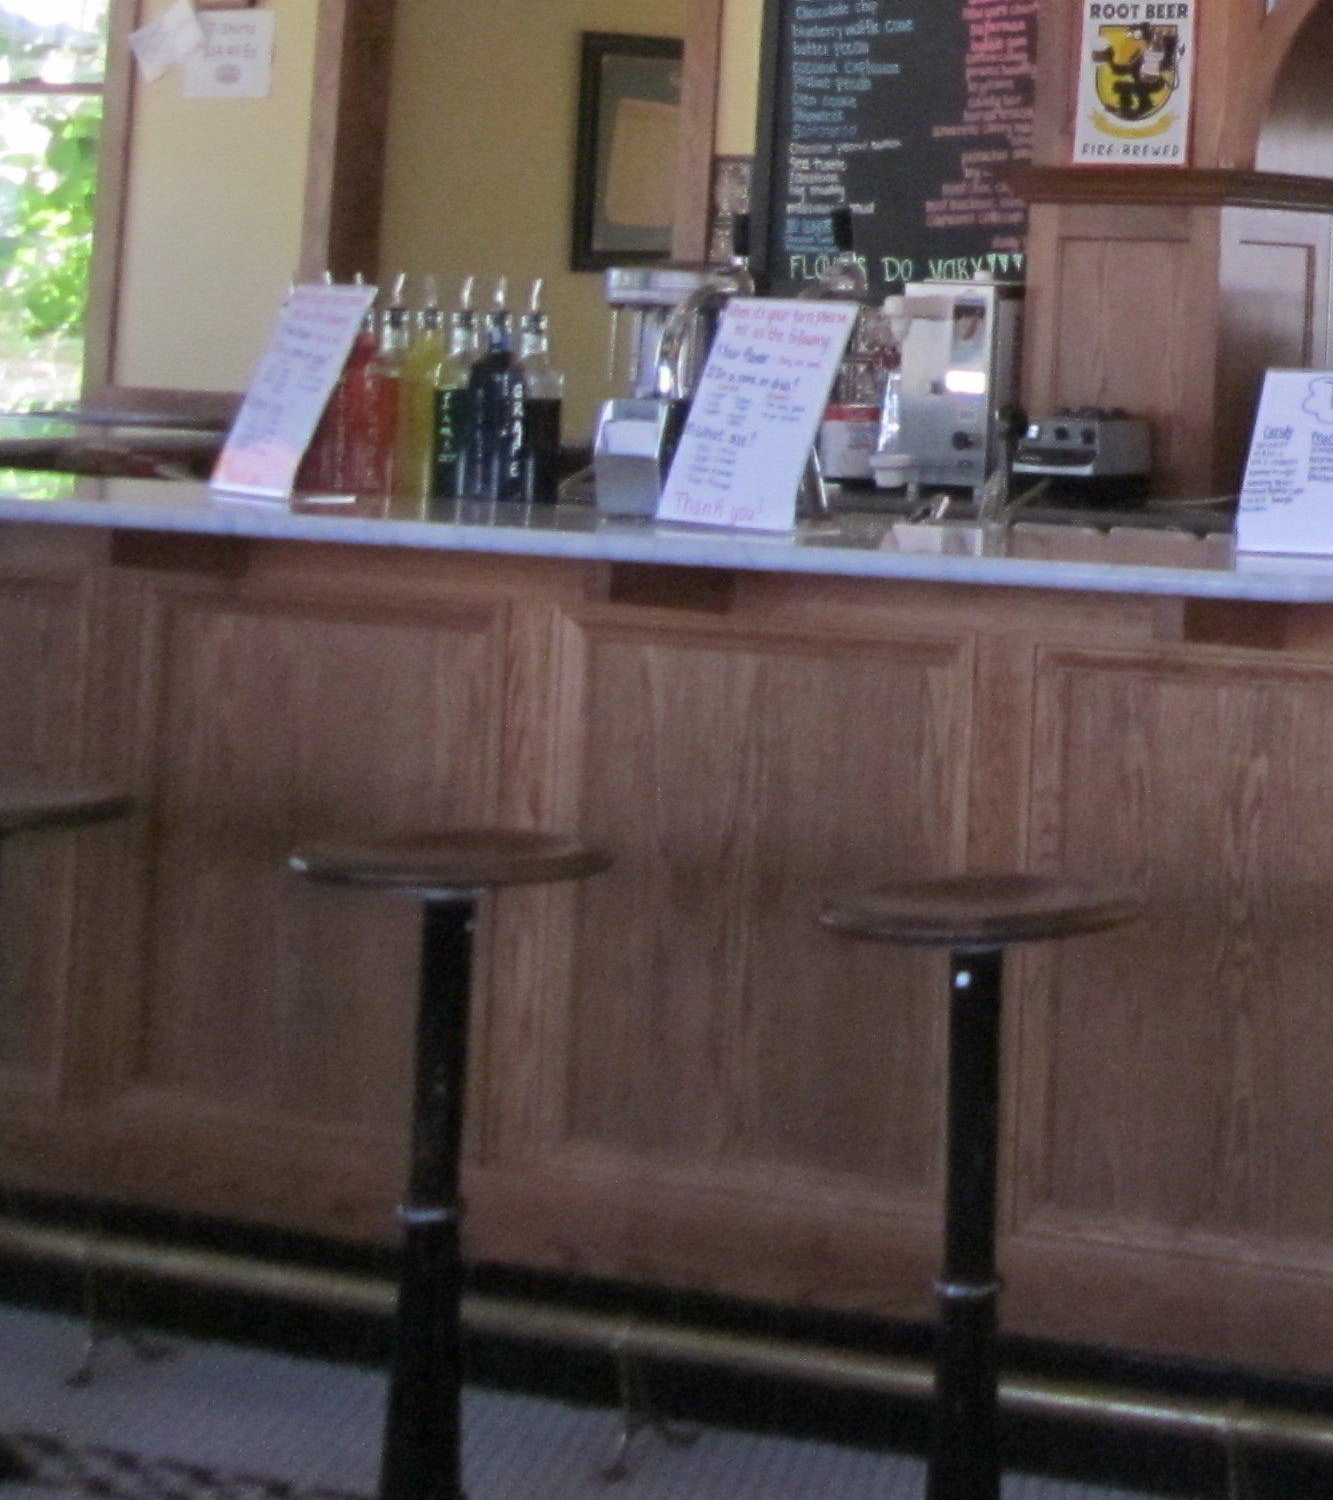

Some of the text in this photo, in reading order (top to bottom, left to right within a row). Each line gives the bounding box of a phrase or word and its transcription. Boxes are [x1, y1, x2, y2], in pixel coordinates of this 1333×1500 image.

[1089, 3, 1189, 19] ROOT BEER
[881, 256, 913, 282] DO
